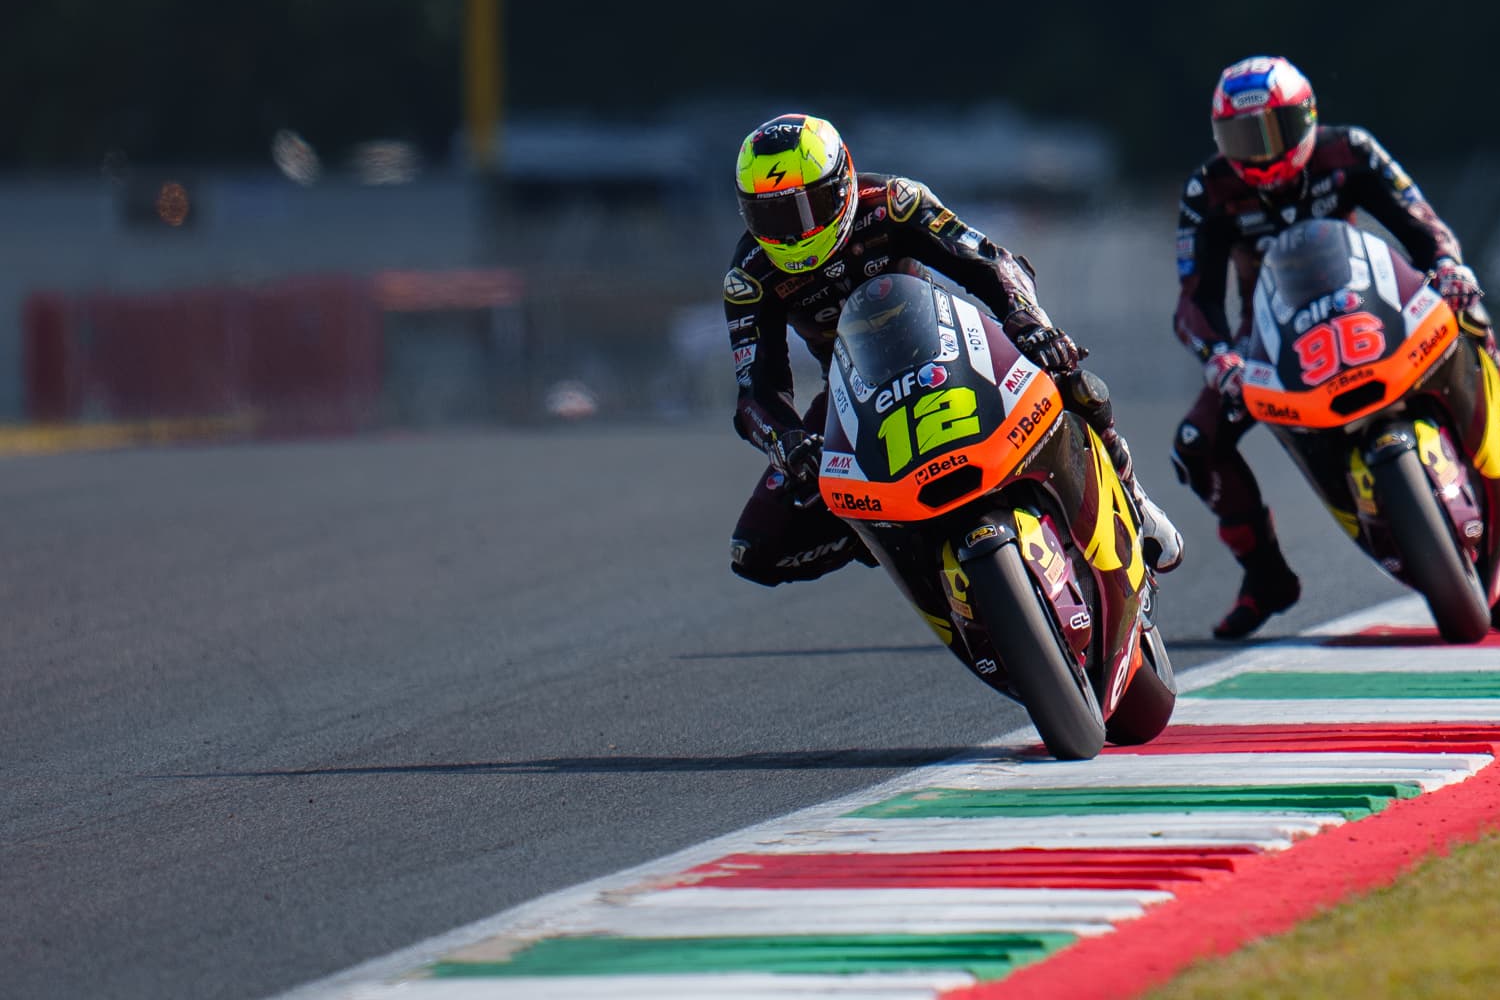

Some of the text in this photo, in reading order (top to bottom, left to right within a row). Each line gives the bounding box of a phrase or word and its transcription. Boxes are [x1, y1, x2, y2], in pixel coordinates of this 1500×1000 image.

[1292, 311, 1386, 386] 96
[875, 372, 916, 414] elf
[1005, 368, 1027, 392] MAX
[877, 387, 980, 477] 12
[1018, 397, 1052, 436] Beta
[827, 456, 853, 469] MAX
[928, 453, 969, 477] Beta
[843, 493, 882, 512] Beta
